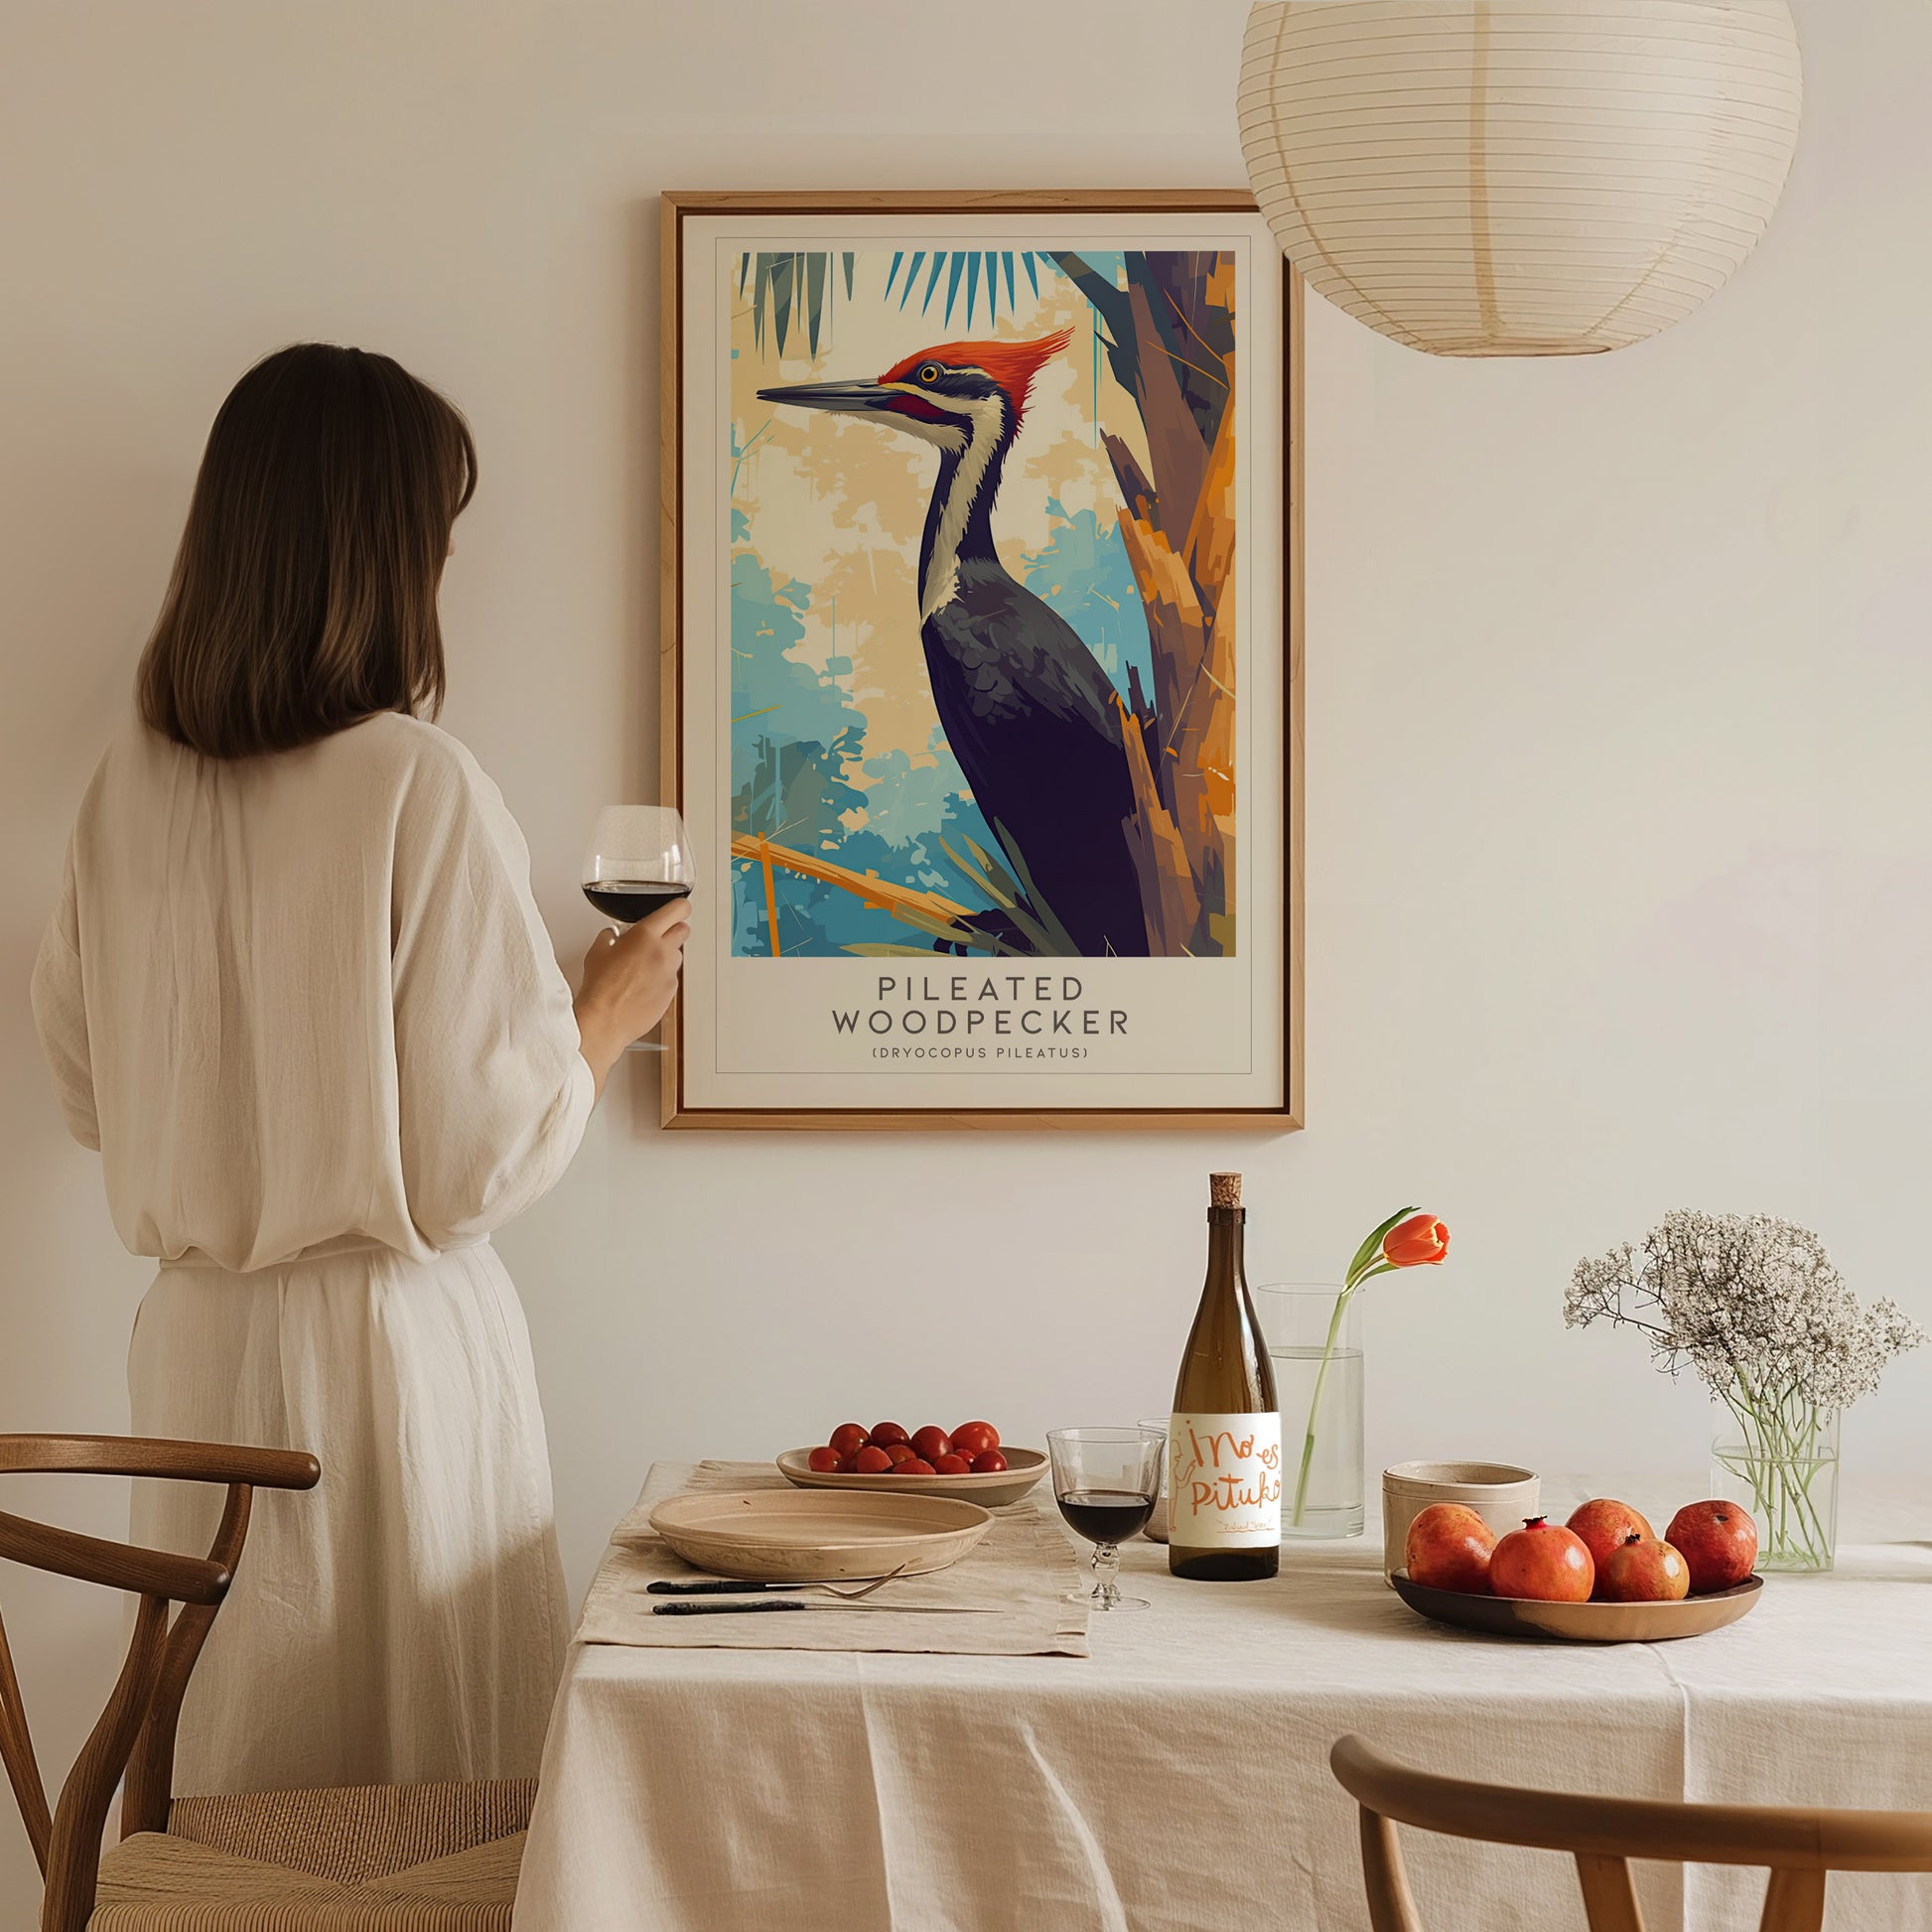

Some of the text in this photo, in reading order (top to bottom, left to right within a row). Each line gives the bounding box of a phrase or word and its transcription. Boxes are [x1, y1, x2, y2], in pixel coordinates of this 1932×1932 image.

[878, 976, 1083, 1002] PILEATED
[831, 1010, 1128, 1035] WOODPECKER
[872, 1046, 1088, 1059] (DRYOCOPUS PILEATUS)
[1256, 1444, 1279, 1469] es
